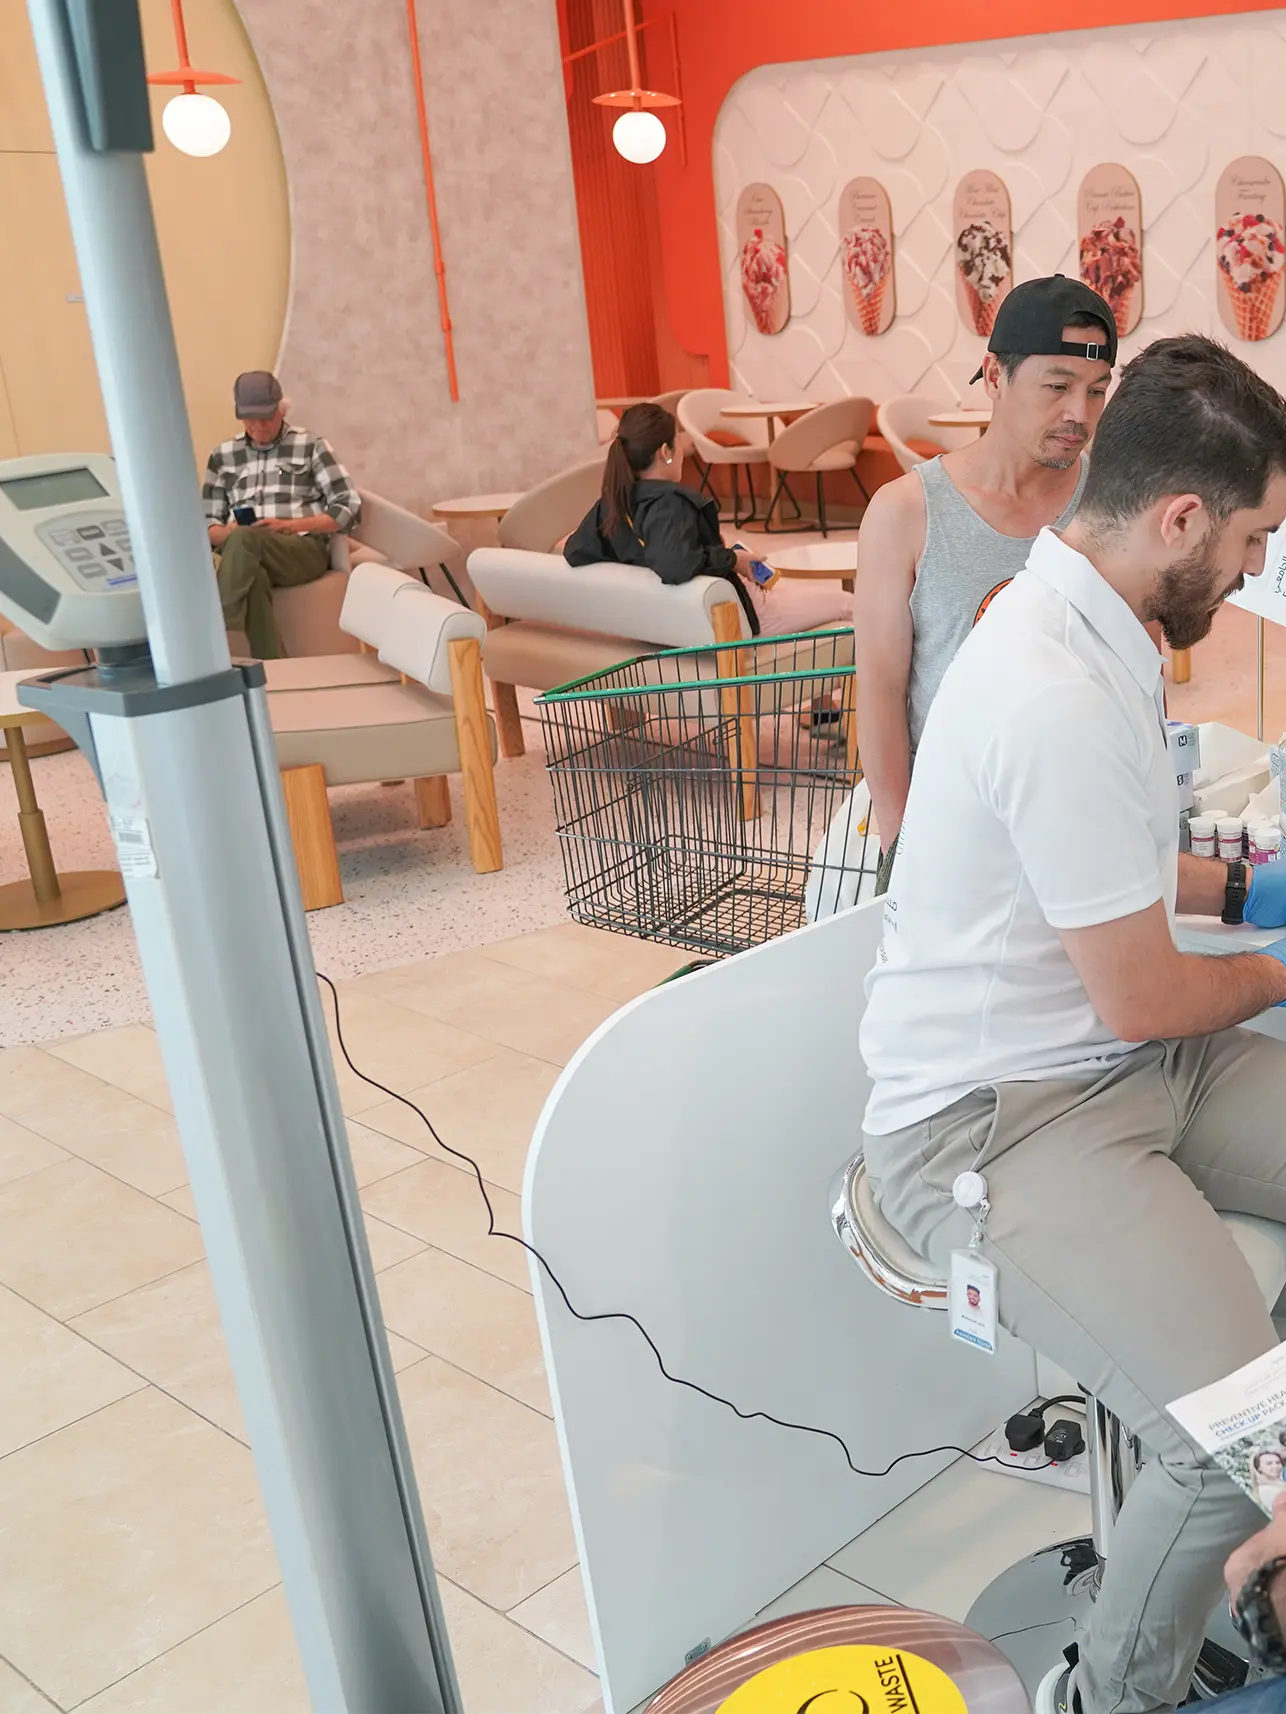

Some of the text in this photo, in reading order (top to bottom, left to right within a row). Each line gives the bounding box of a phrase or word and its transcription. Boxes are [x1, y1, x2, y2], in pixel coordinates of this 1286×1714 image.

[1208, 1399, 1266, 1431] PREVENTIVE
[1215, 1420, 1245, 1437] CHECK
[1248, 1413, 1261, 1424] UP
[874, 1656, 908, 1713] WASTE
